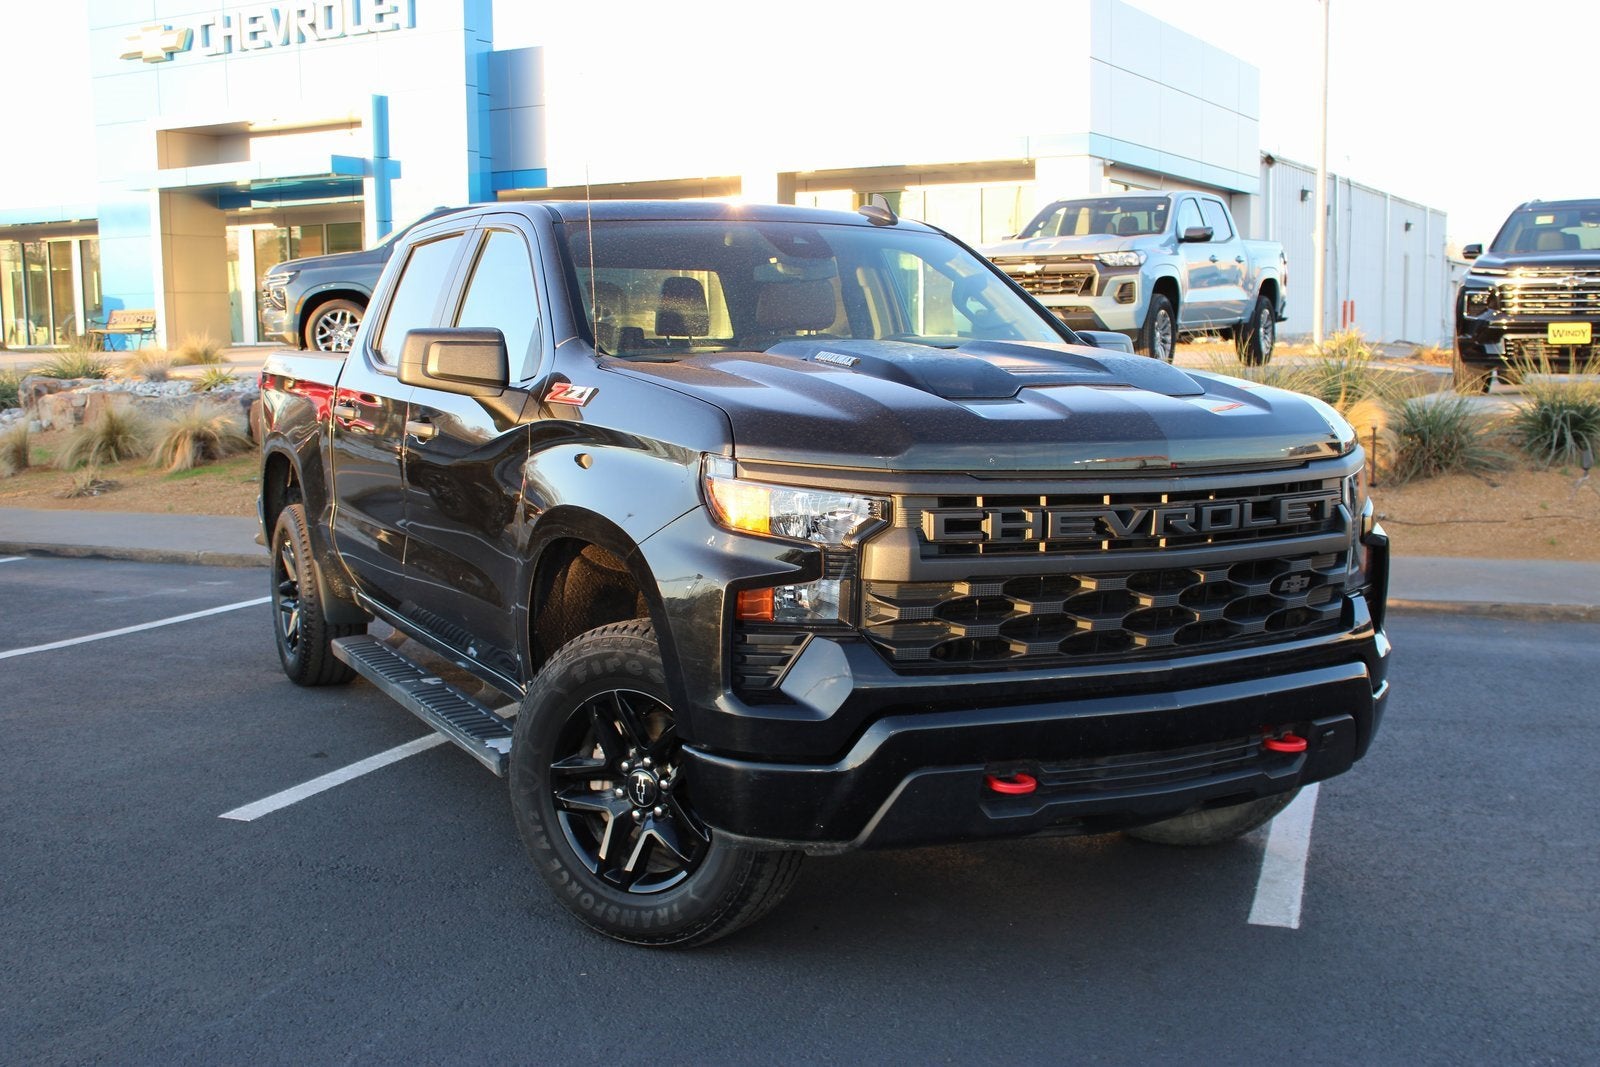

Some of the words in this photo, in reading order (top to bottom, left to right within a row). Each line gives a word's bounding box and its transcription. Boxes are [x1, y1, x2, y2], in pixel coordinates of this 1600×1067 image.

[1551, 328, 1588, 339] WINDY
[921, 491, 1342, 541] CHEVROLET
[545, 857, 683, 928] TRANSFORCE
